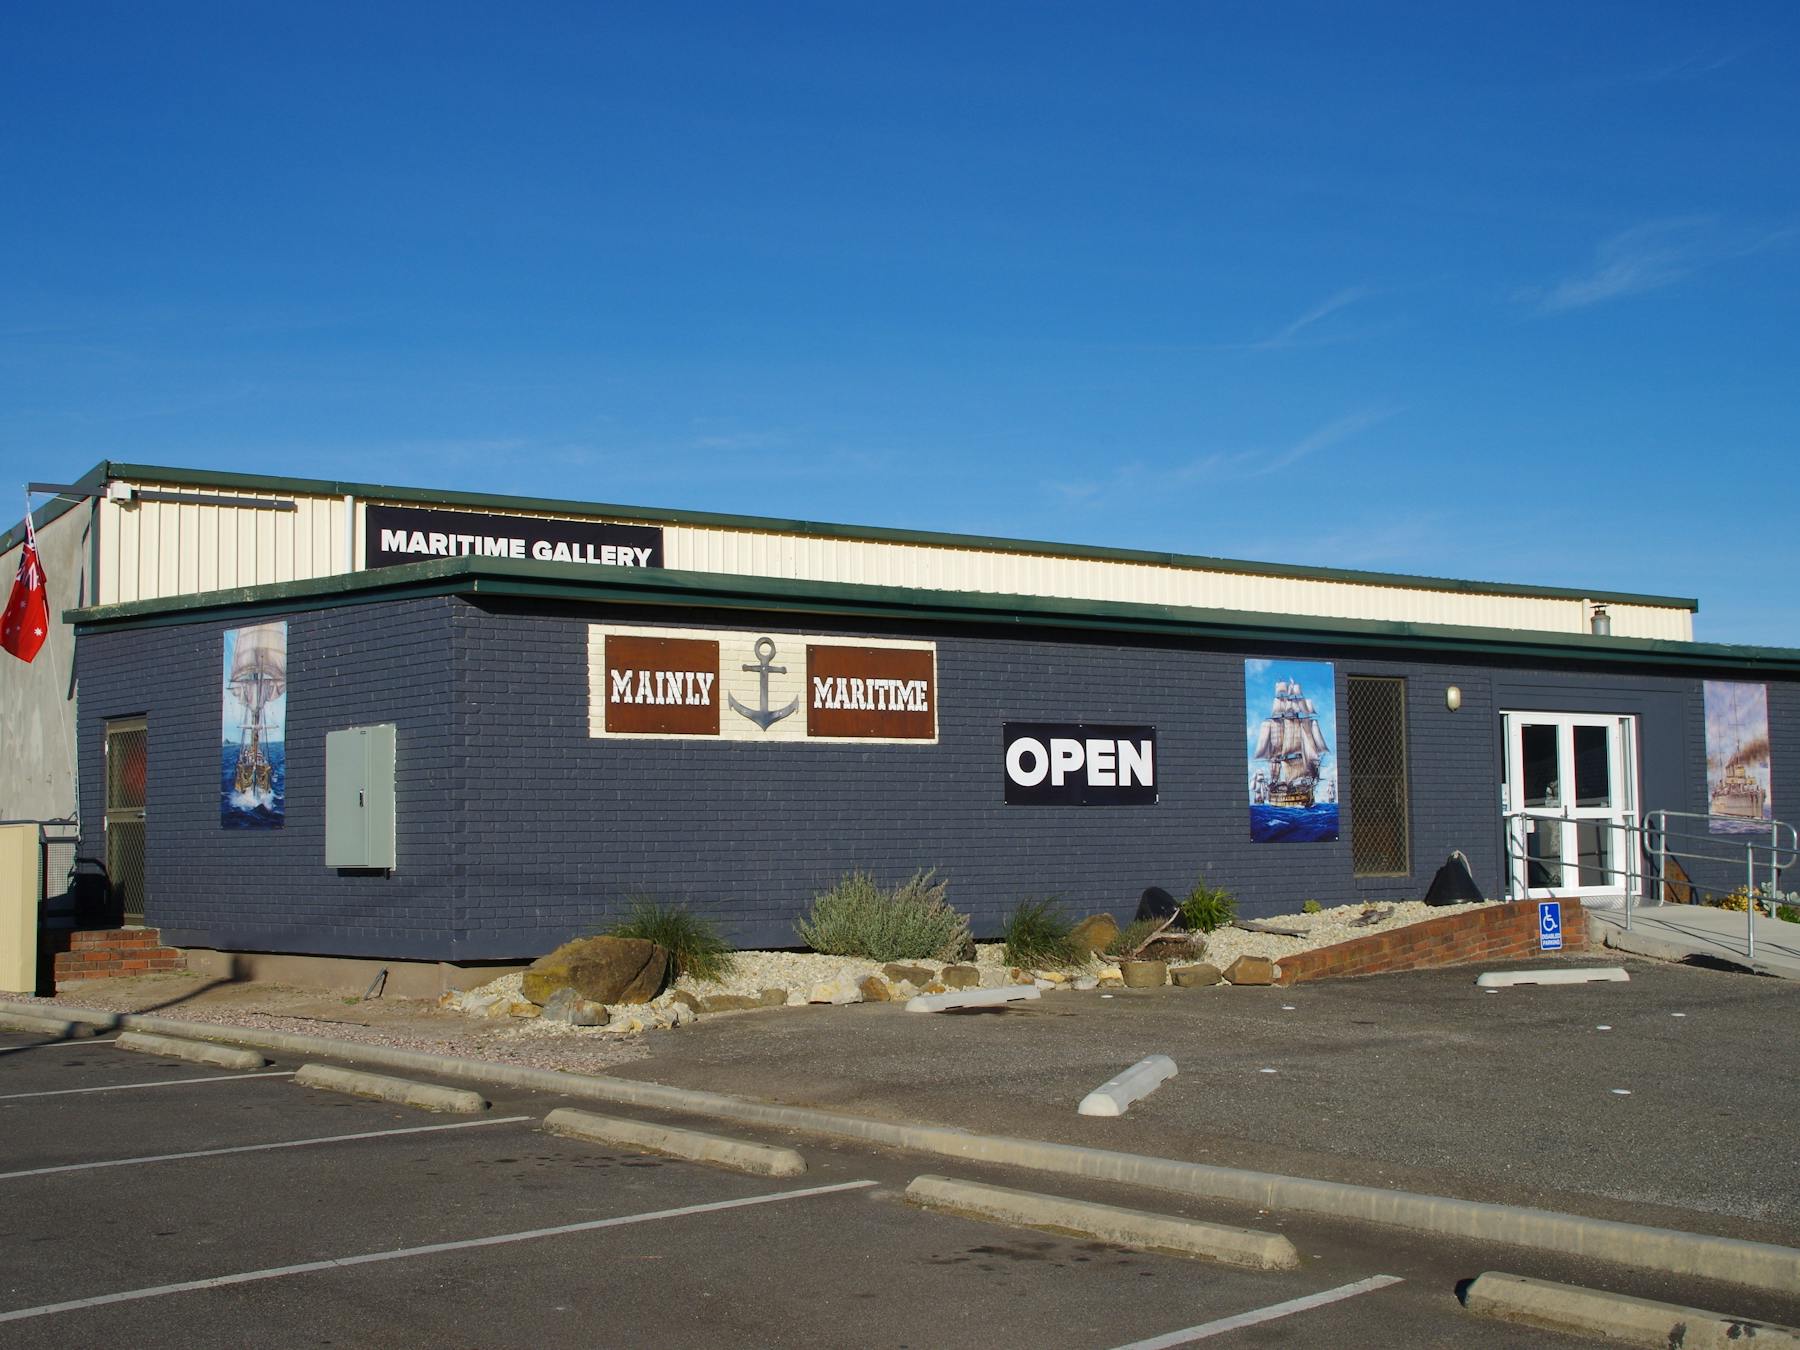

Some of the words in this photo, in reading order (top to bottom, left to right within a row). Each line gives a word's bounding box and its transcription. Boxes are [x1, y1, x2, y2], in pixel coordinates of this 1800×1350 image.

[381, 528, 526, 560] MARITIME
[532, 540, 653, 568] GALLERY
[610, 669, 715, 706] MAINLY
[813, 676, 929, 712] MARITIME
[1005, 736, 1154, 788] OPEN
